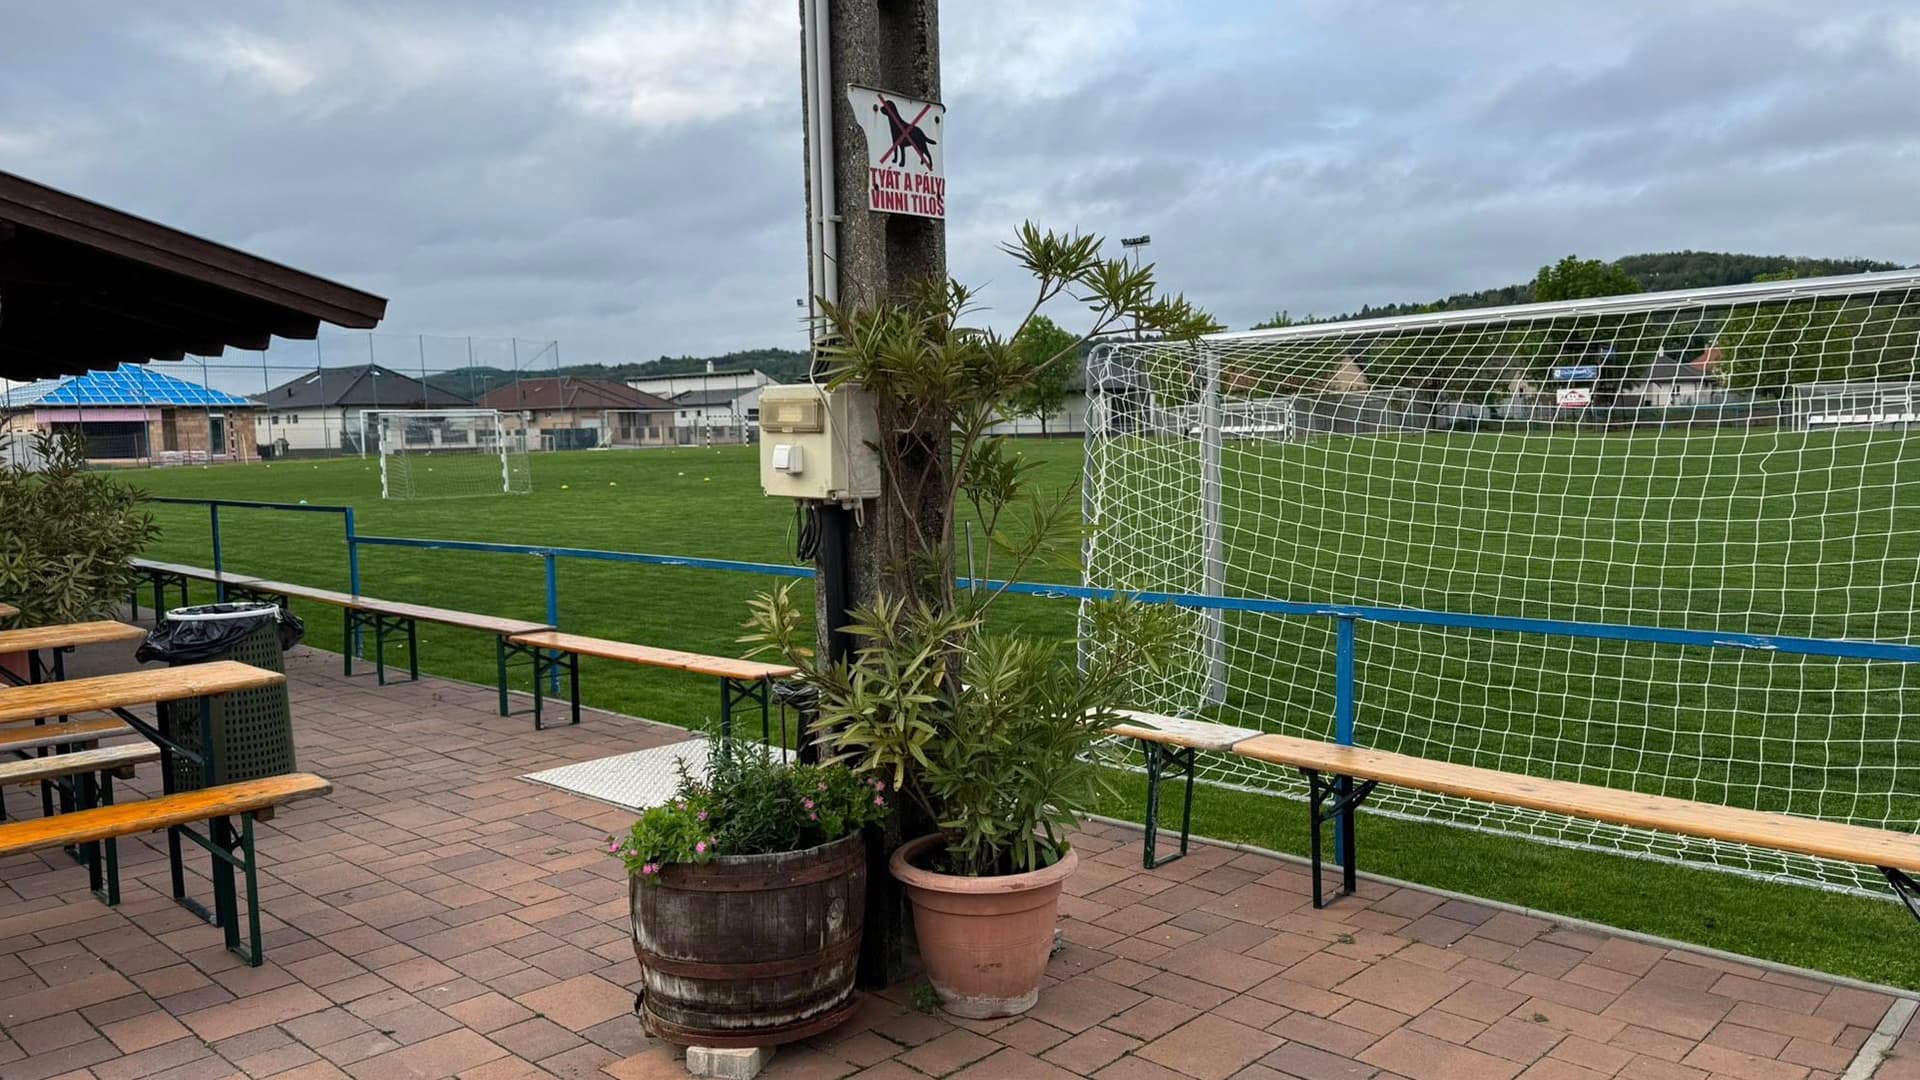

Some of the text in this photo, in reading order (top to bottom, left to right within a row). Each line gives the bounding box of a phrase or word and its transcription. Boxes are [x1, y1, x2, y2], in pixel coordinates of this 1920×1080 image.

[904, 172, 912, 191] A
[872, 189, 945, 216] VINNI TILOS
